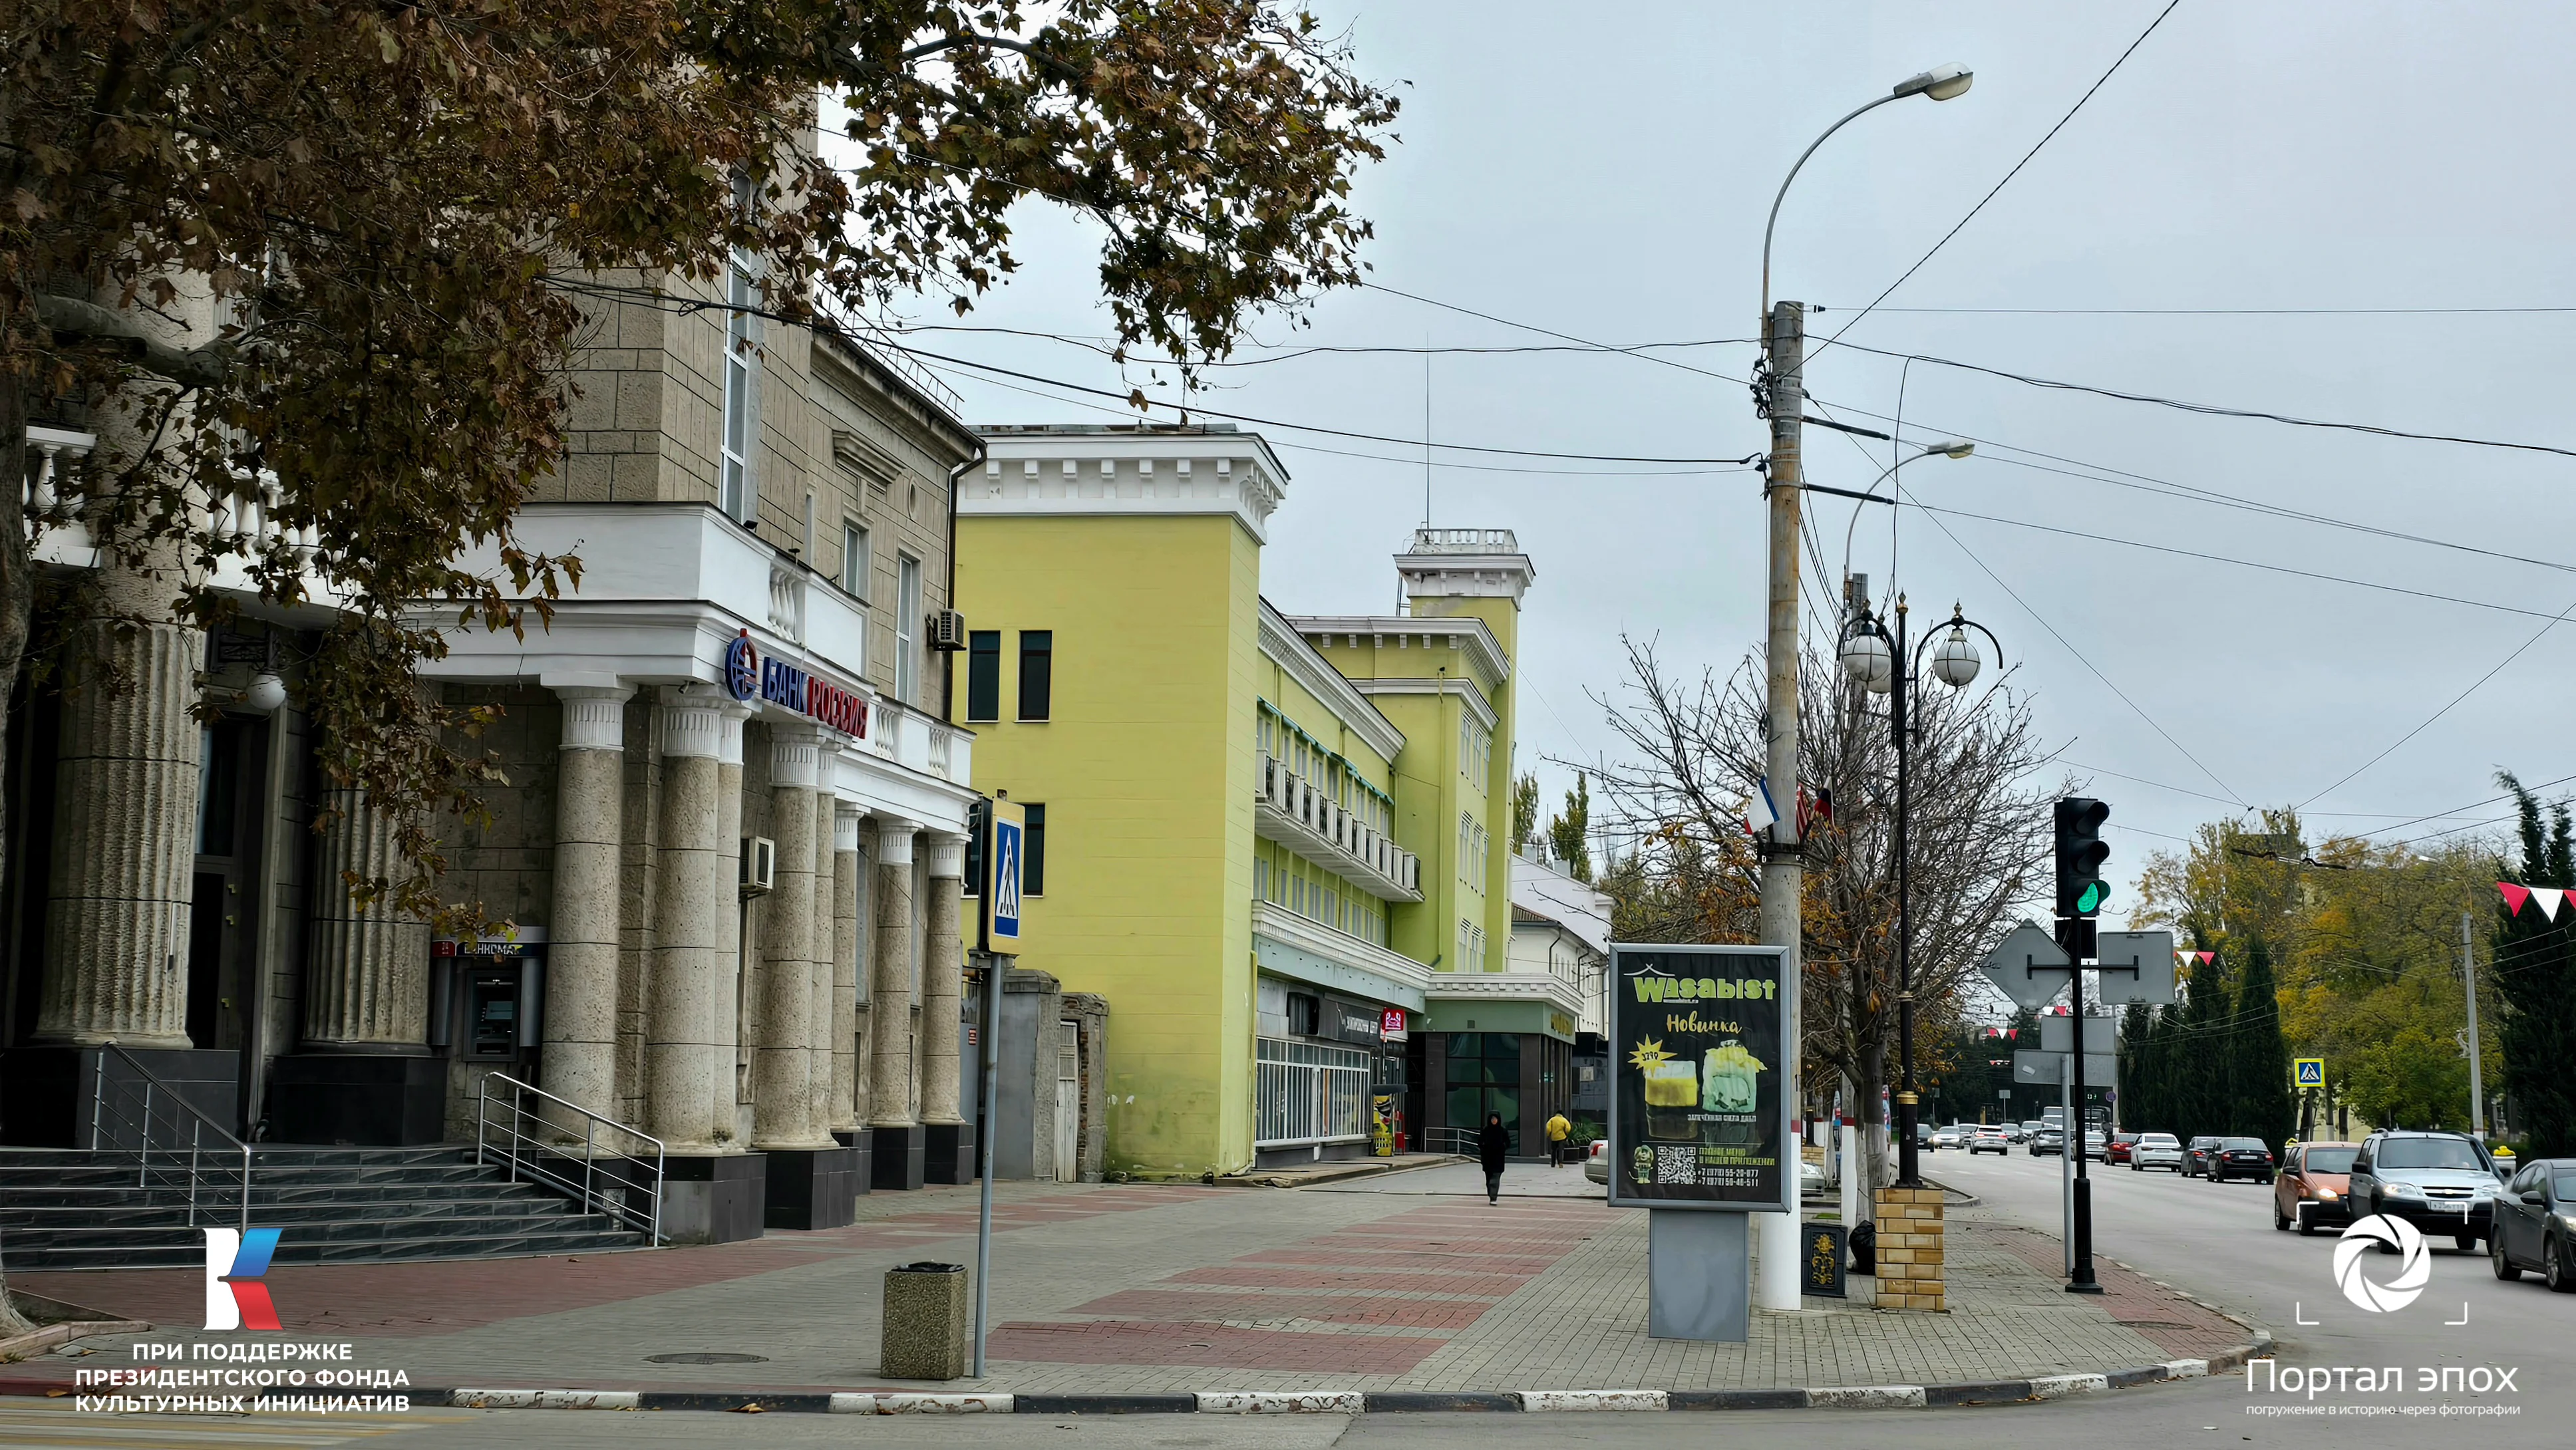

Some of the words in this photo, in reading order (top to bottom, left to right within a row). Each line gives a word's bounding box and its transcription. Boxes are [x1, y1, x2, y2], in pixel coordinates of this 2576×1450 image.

[762, 656, 808, 713] БАНК
[807, 675, 868, 740] РОССИЯ
[1667, 1010, 1742, 1034] Новинка
